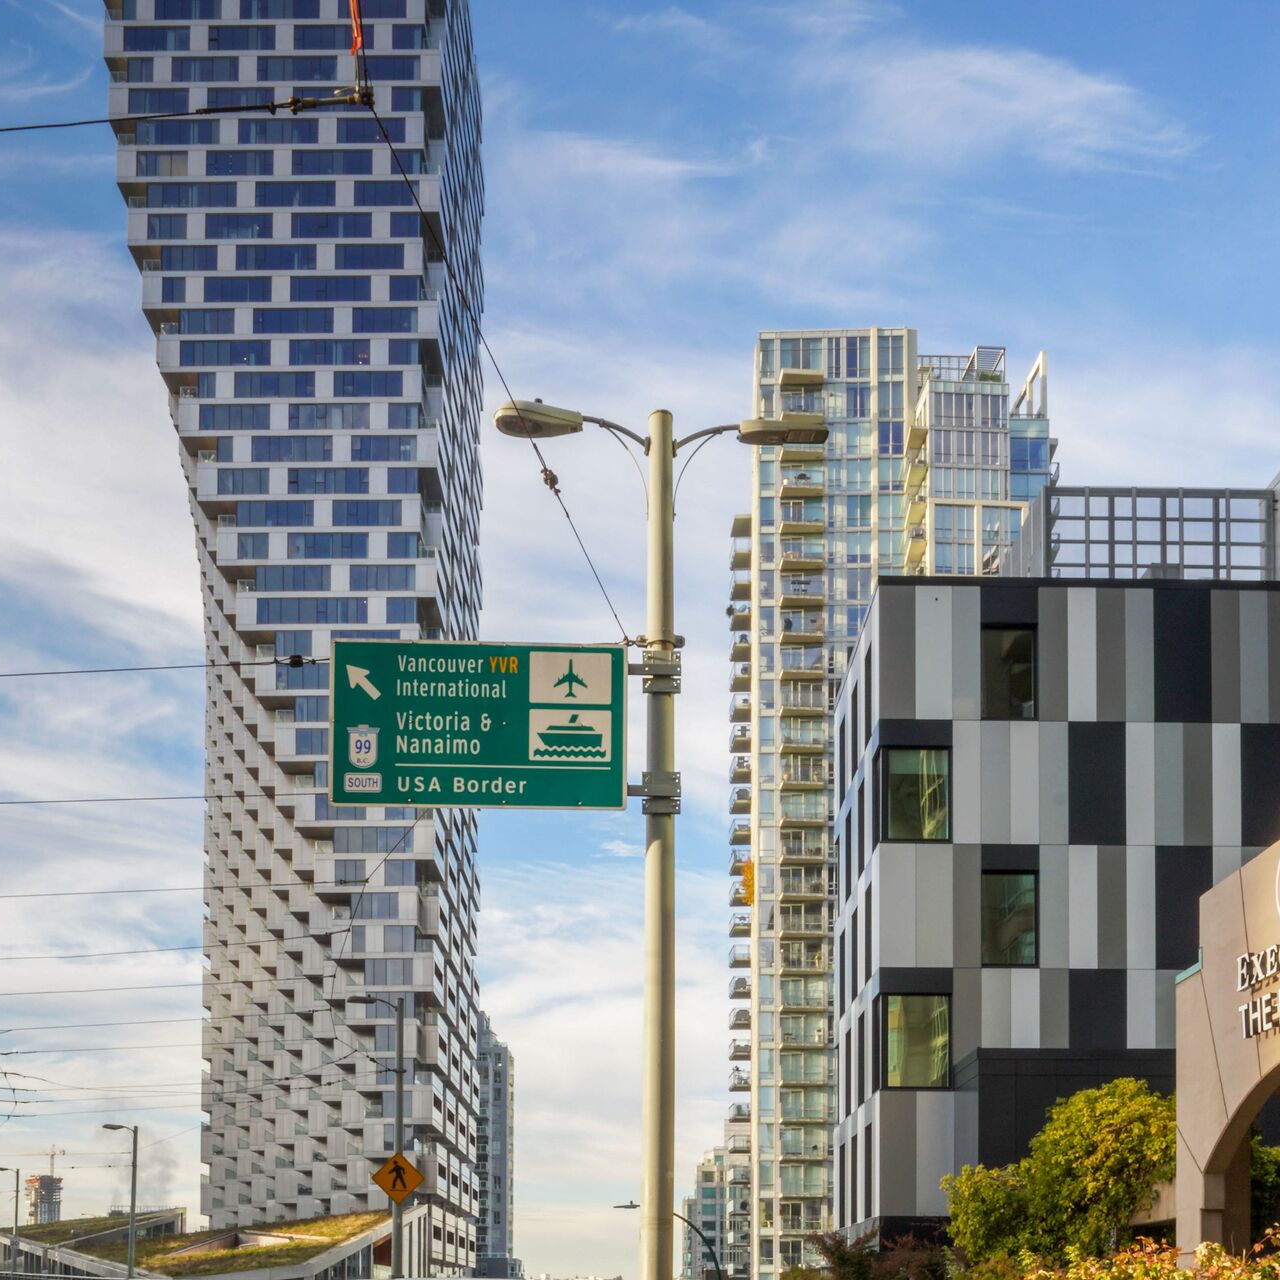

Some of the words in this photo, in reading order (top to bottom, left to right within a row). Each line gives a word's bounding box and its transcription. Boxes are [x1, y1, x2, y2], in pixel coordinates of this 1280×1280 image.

[398, 655, 484, 673] Vancouver
[490, 656, 519, 673] YVR
[397, 679, 507, 698] International
[396, 711, 471, 731] Victoria
[481, 714, 492, 731] &
[355, 739, 371, 754] 99
[396, 735, 481, 755] Nanaimo
[347, 777, 379, 788] SOUTH
[397, 776, 442, 793] USA
[453, 777, 527, 794] Border
[1238, 992, 1272, 1040] THE
